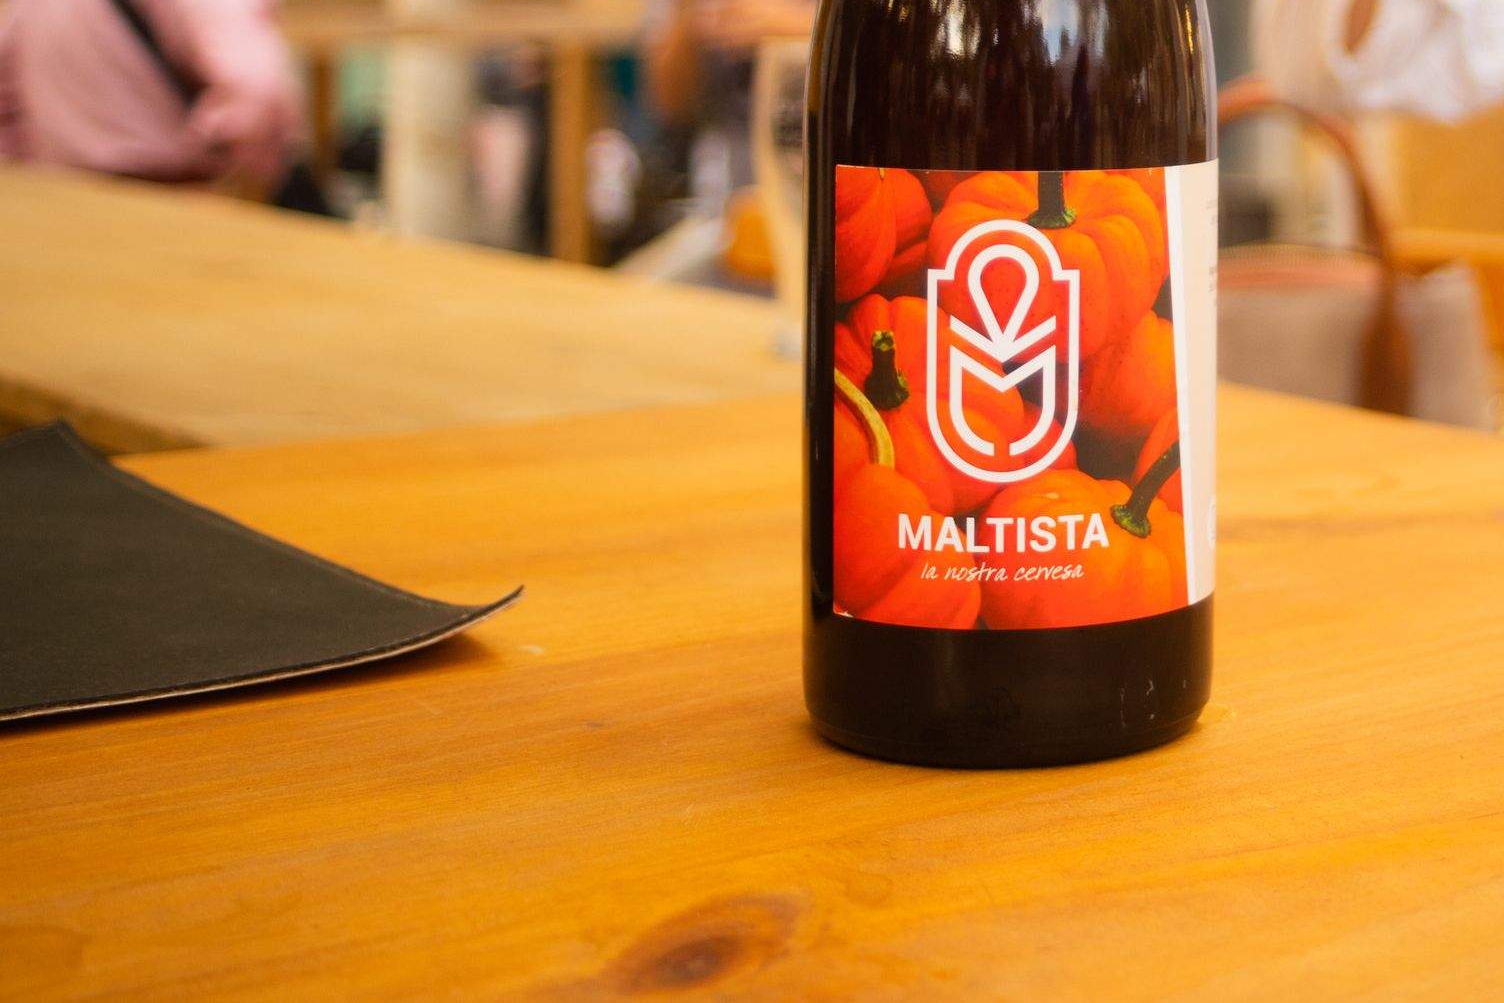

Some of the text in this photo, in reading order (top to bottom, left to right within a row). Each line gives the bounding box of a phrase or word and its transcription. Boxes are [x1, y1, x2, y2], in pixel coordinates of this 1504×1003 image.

[898, 513, 1110, 553] MALTISTA
[921, 562, 1084, 582] la nostra cervesa
